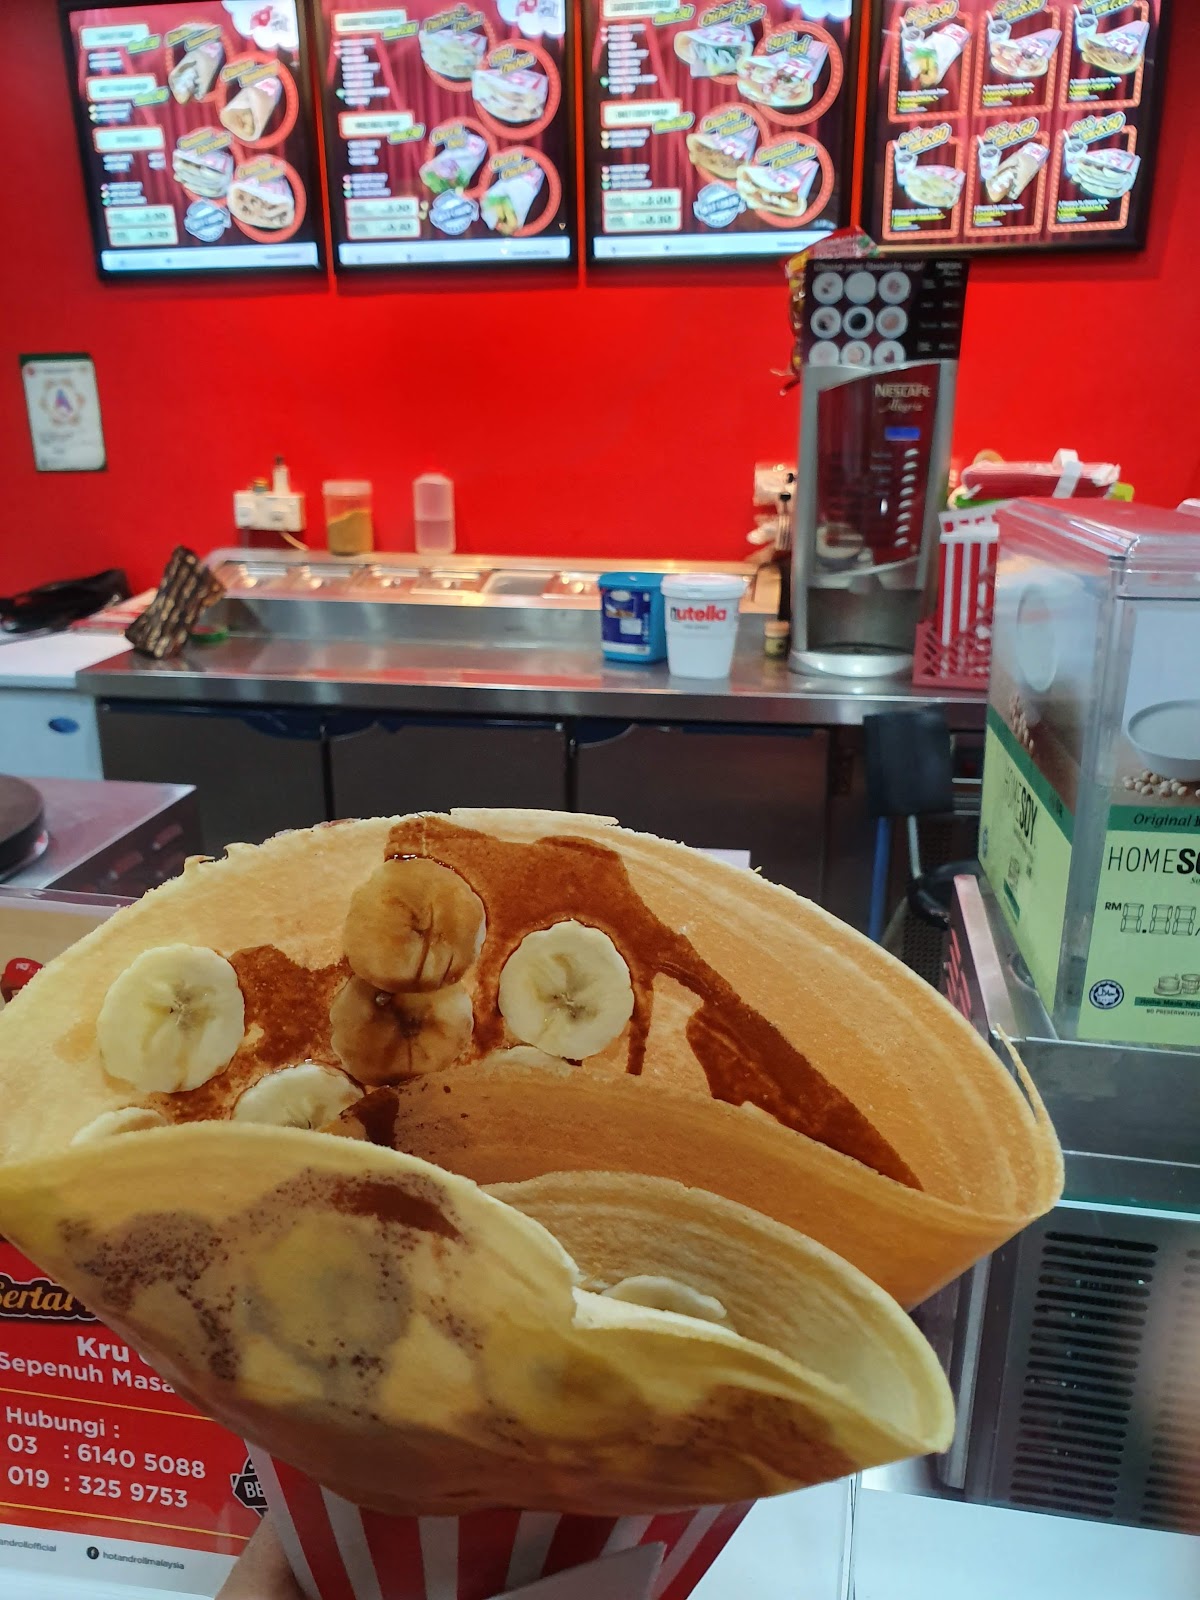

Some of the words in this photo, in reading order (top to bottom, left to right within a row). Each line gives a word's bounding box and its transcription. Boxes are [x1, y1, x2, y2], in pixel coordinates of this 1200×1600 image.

[1133, 812, 1193, 829] Original
[1107, 846, 1200, 875] HOMES
[1104, 901, 1122, 911] RM
[76, 1335, 130, 1363] Kru
[0, 1352, 104, 1384] Sepenuh
[6, 1406, 105, 1439] Hubungi
[7, 1433, 38, 1455] 03
[77, 1443, 136, 1468] 6140
[144, 1452, 206, 1479] 5088
[7, 1465, 49, 1489] 019
[78, 1474, 122, 1499] 325
[130, 1482, 188, 1508] 9753
